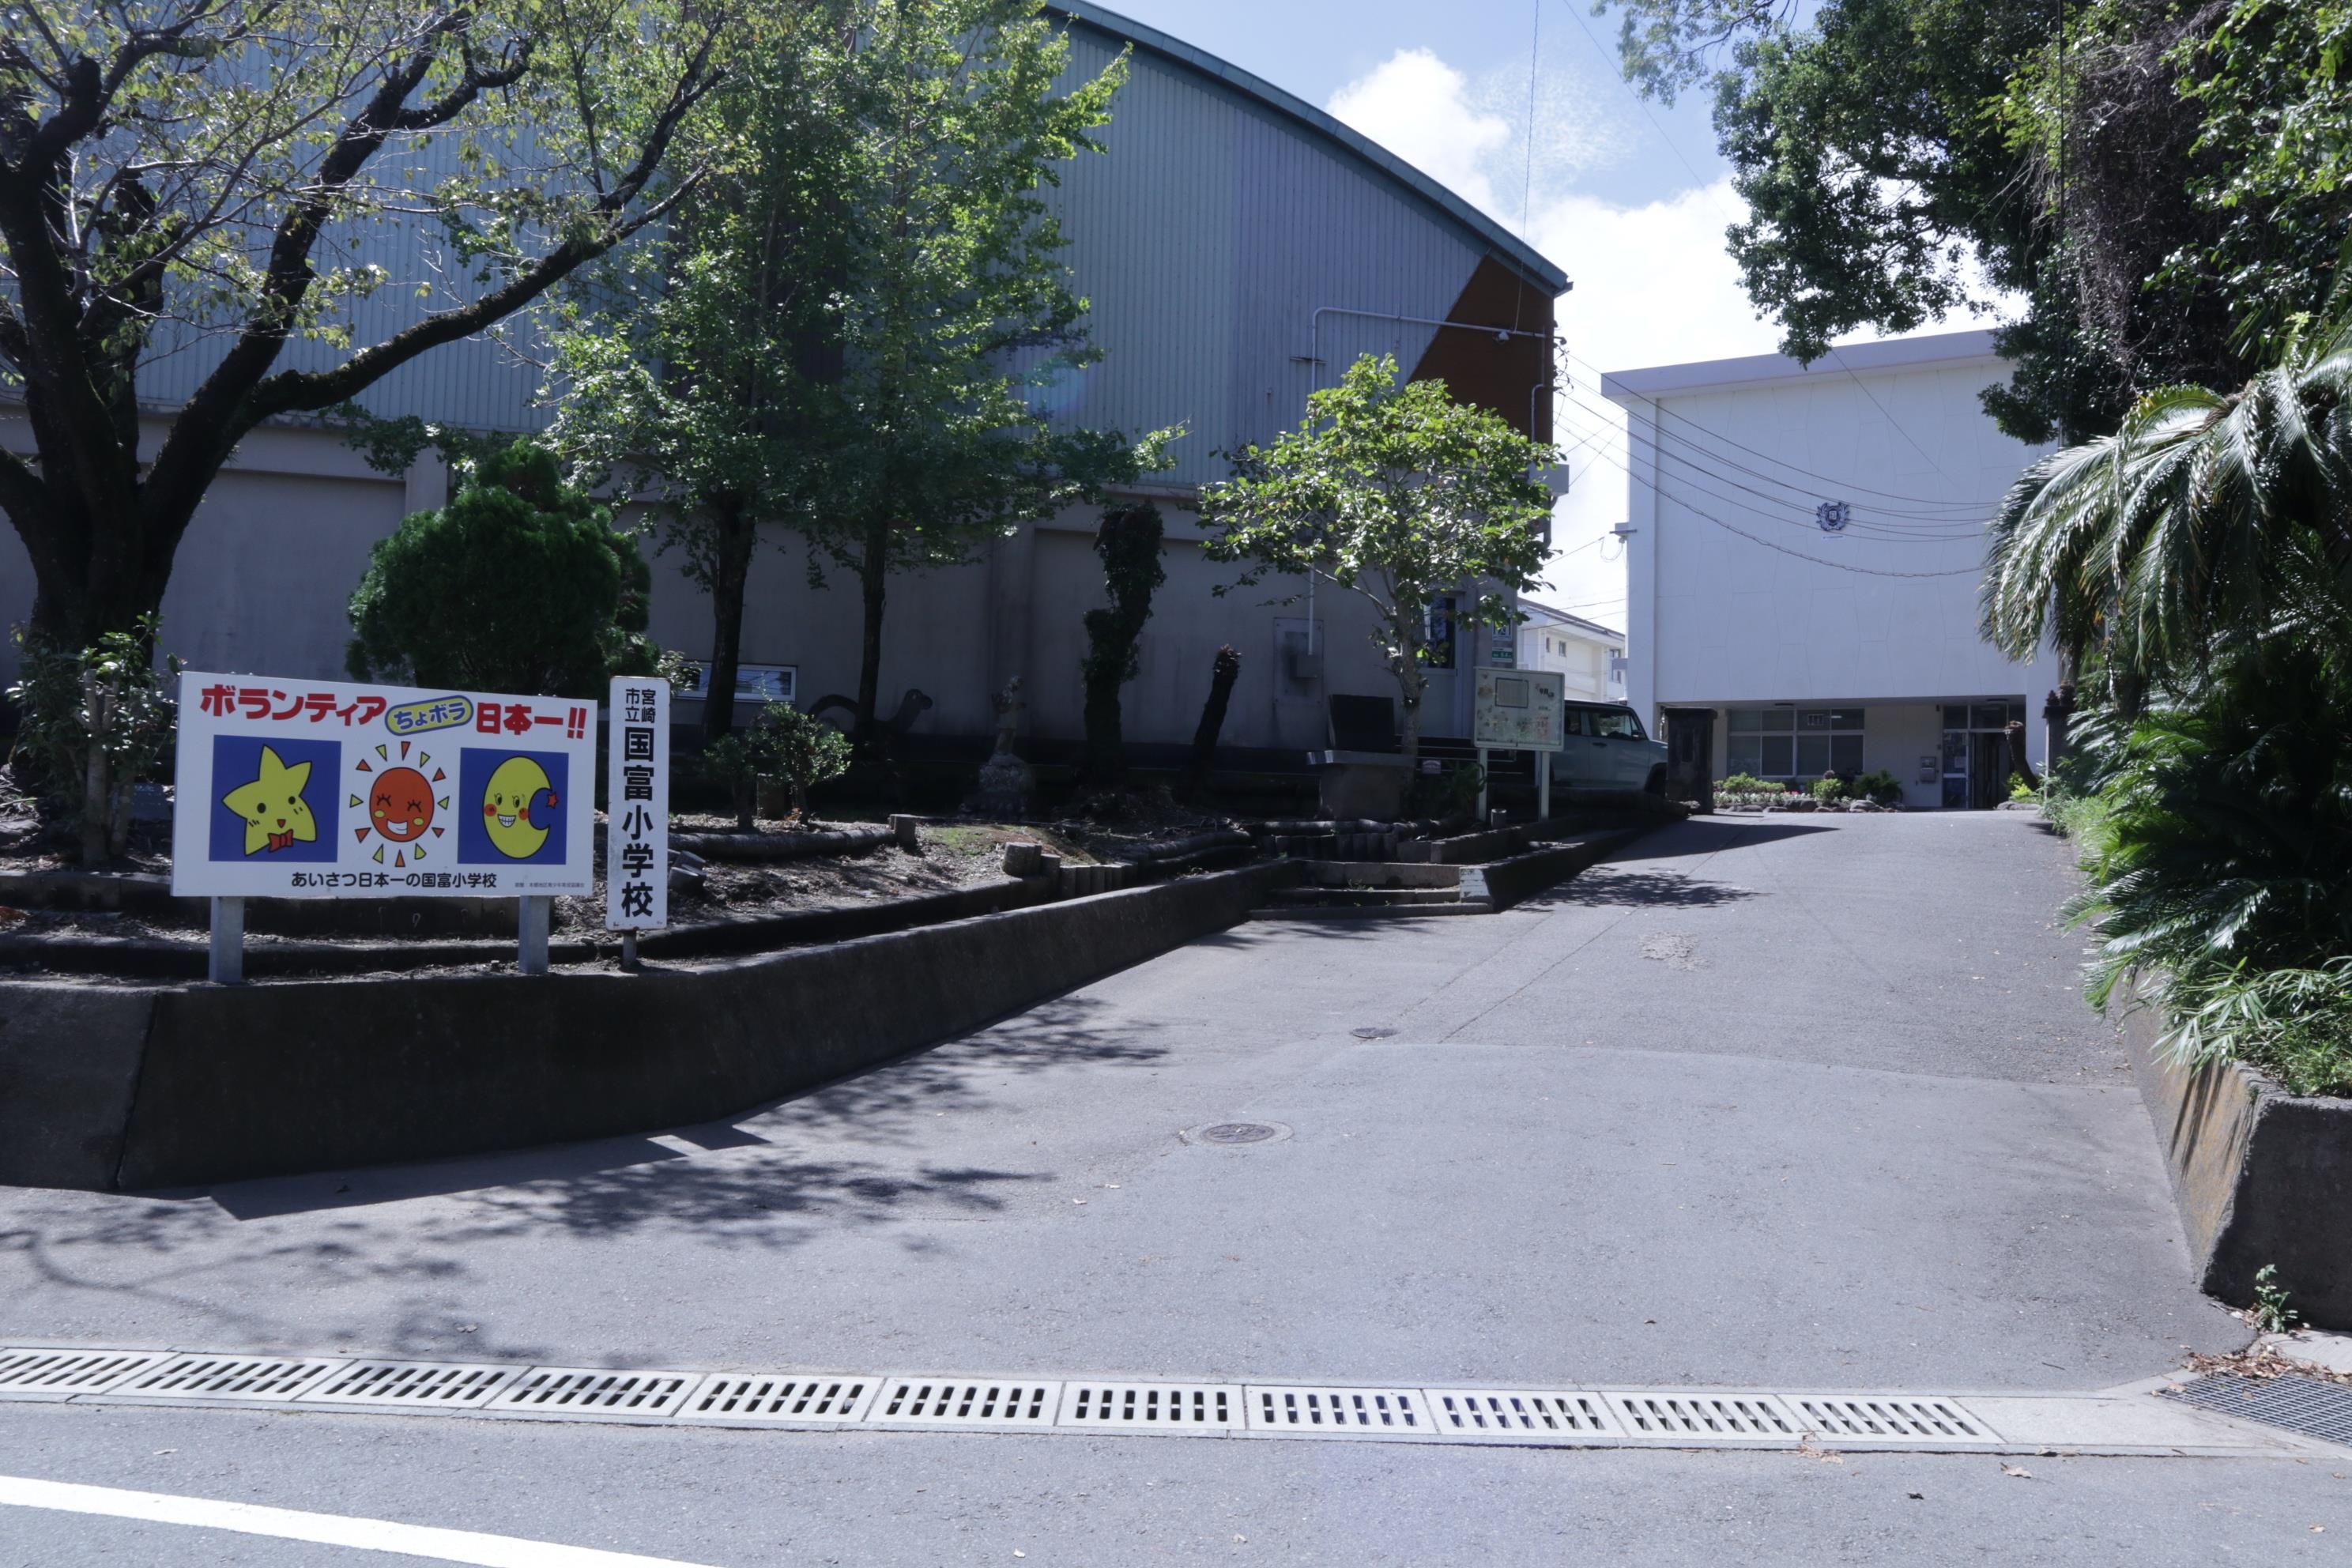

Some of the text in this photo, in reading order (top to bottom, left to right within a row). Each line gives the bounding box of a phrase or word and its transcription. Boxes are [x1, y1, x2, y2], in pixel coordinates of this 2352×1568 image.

[200, 684, 387, 726] ボランティア
[394, 703, 466, 729] ちょボラ
[624, 688, 640, 723] 市立
[641, 688, 657, 723] 宮崎
[620, 726, 655, 918] 国富小学校
[291, 872, 497, 888] あいさつ日本一の国富小学校
